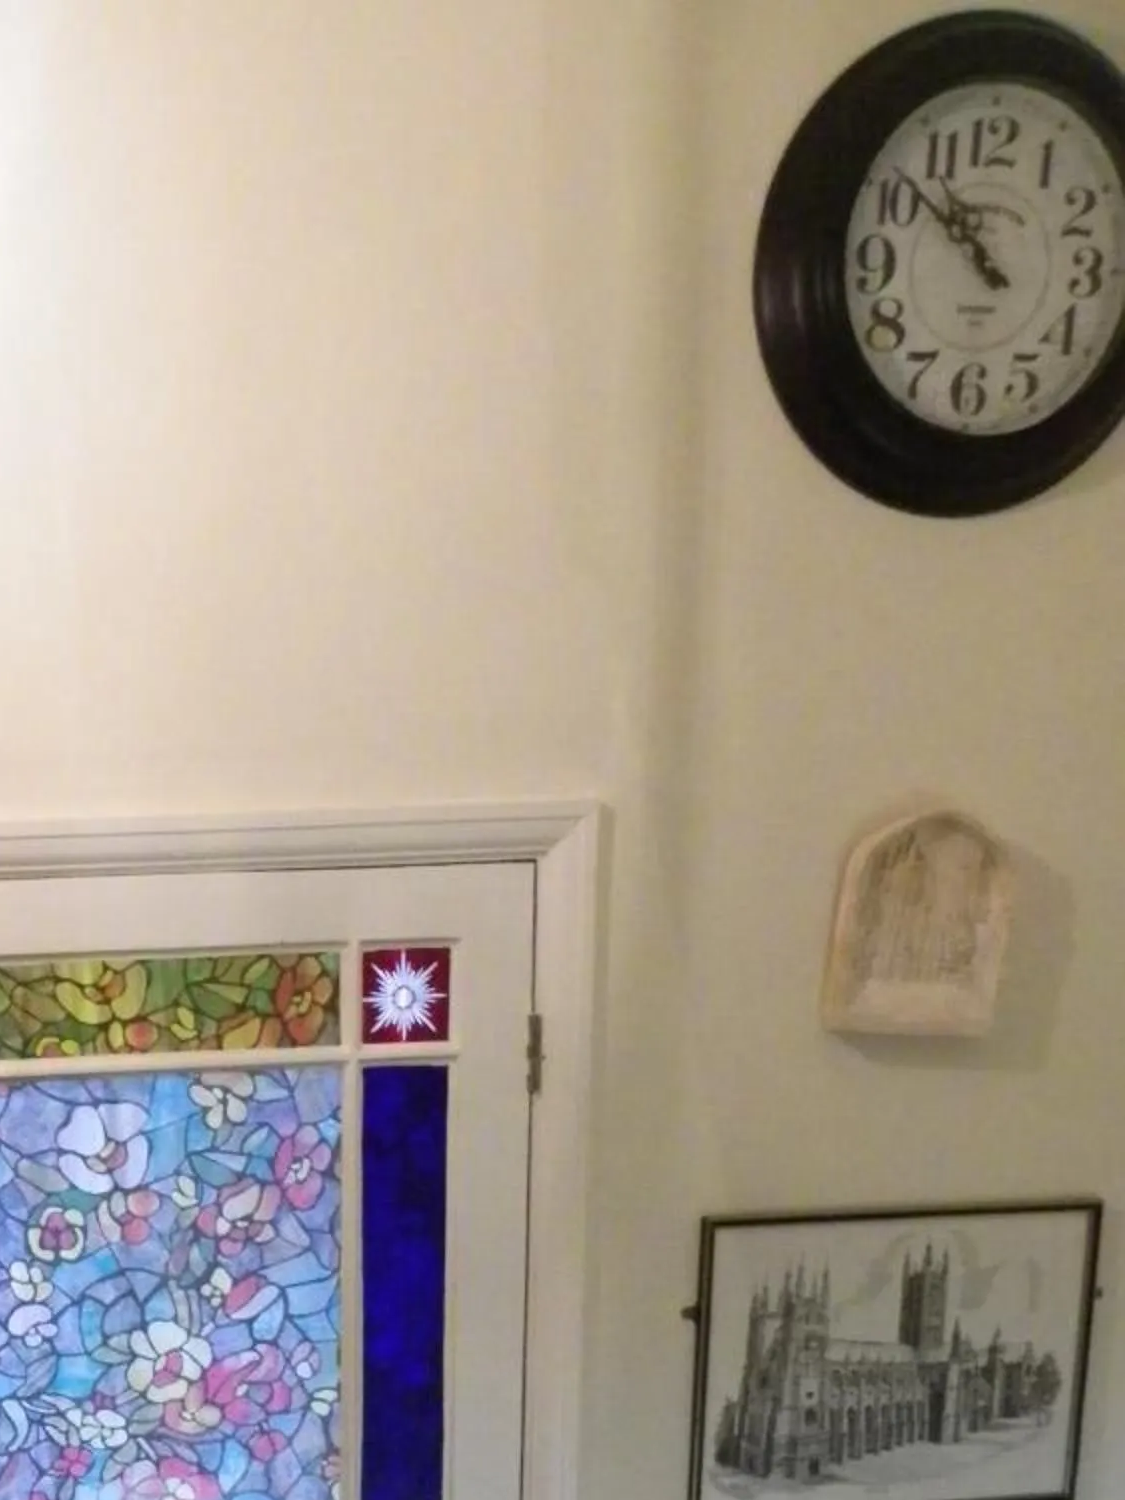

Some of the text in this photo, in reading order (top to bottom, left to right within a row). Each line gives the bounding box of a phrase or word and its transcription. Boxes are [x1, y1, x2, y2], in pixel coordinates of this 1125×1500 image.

[925, 129, 959, 180] 11
[970, 114, 1020, 168] 12
[1038, 139, 1054, 190] 1
[875, 177, 920, 228] 10
[1060, 186, 1097, 239] 2
[855, 234, 896, 295] 9
[1069, 246, 1104, 299] 3
[864, 298, 906, 353] 8
[1038, 303, 1075, 356] 4
[905, 349, 940, 401] 7
[949, 362, 987, 417] 6
[1003, 353, 1040, 403] 5
